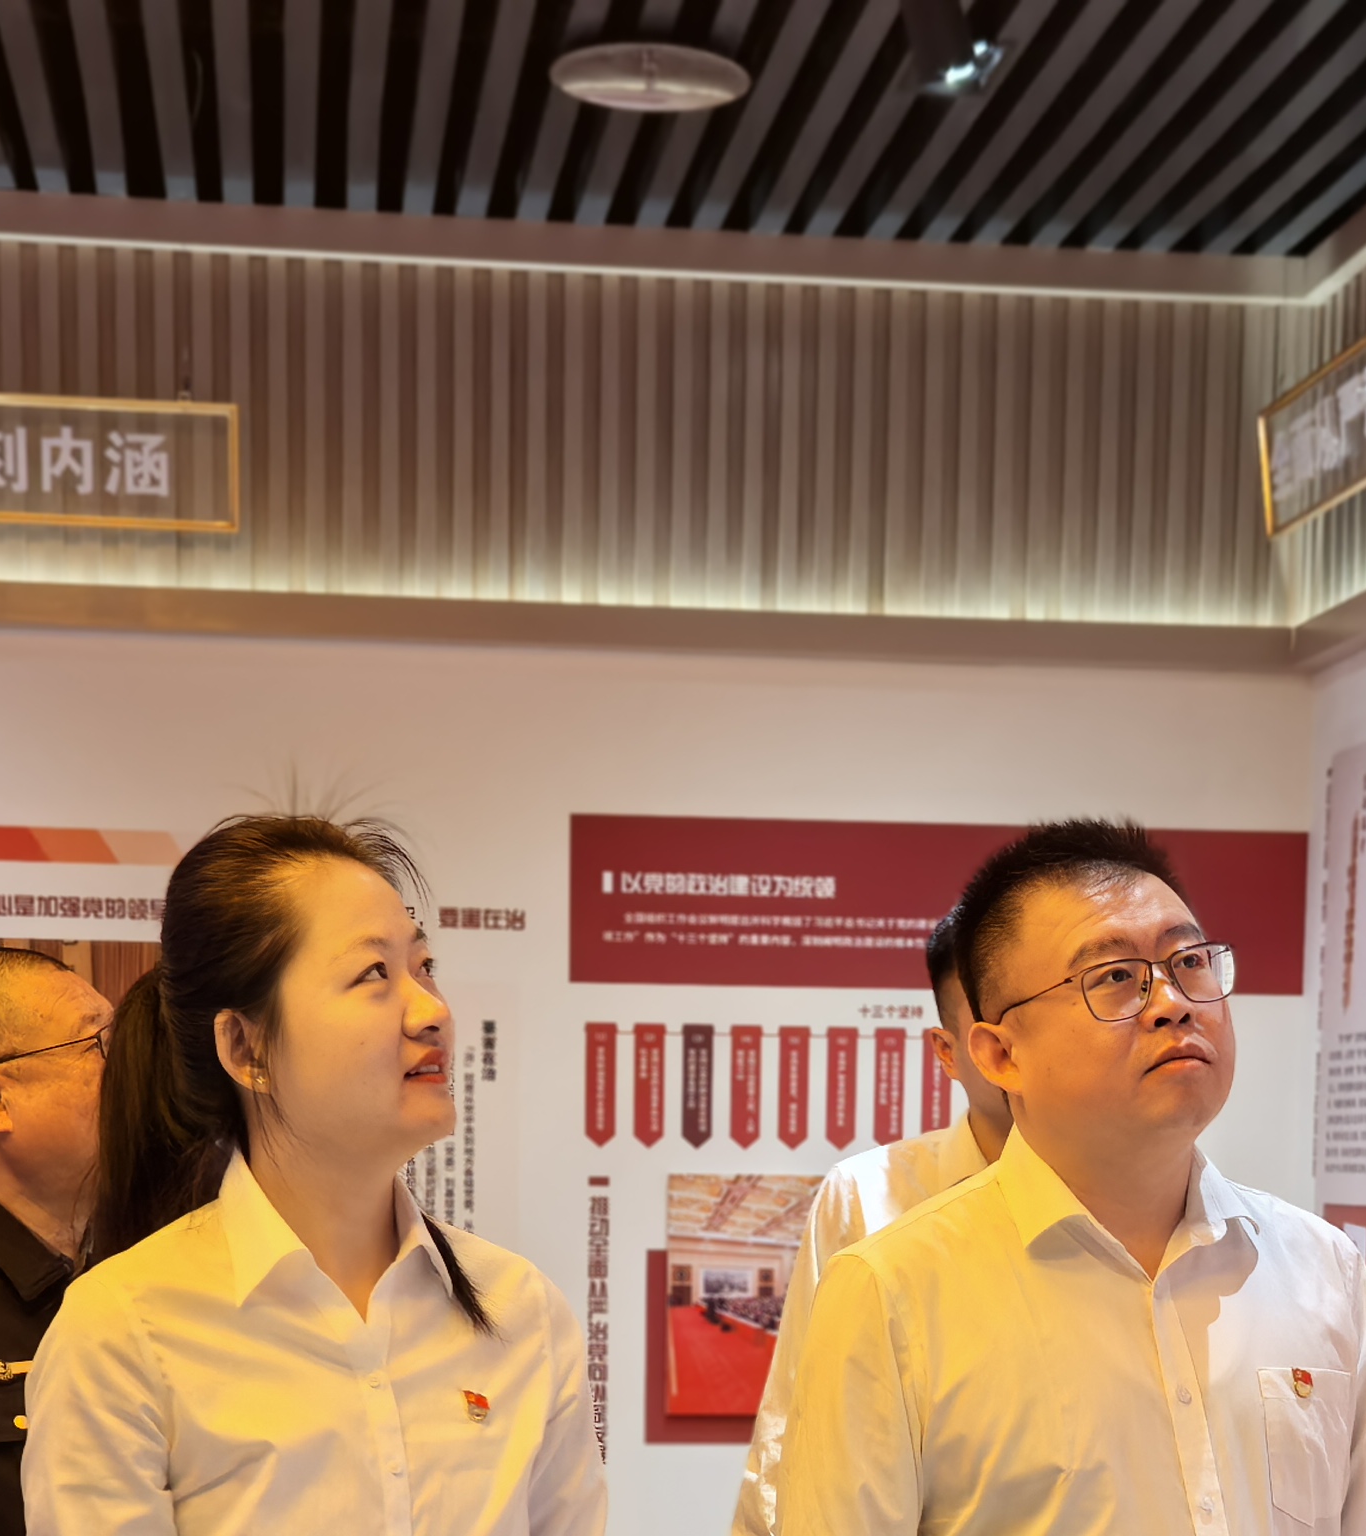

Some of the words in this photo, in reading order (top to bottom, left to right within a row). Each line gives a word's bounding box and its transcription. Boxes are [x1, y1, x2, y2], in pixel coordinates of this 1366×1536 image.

[620, 870, 837, 900] 以党的政治建设为统领
